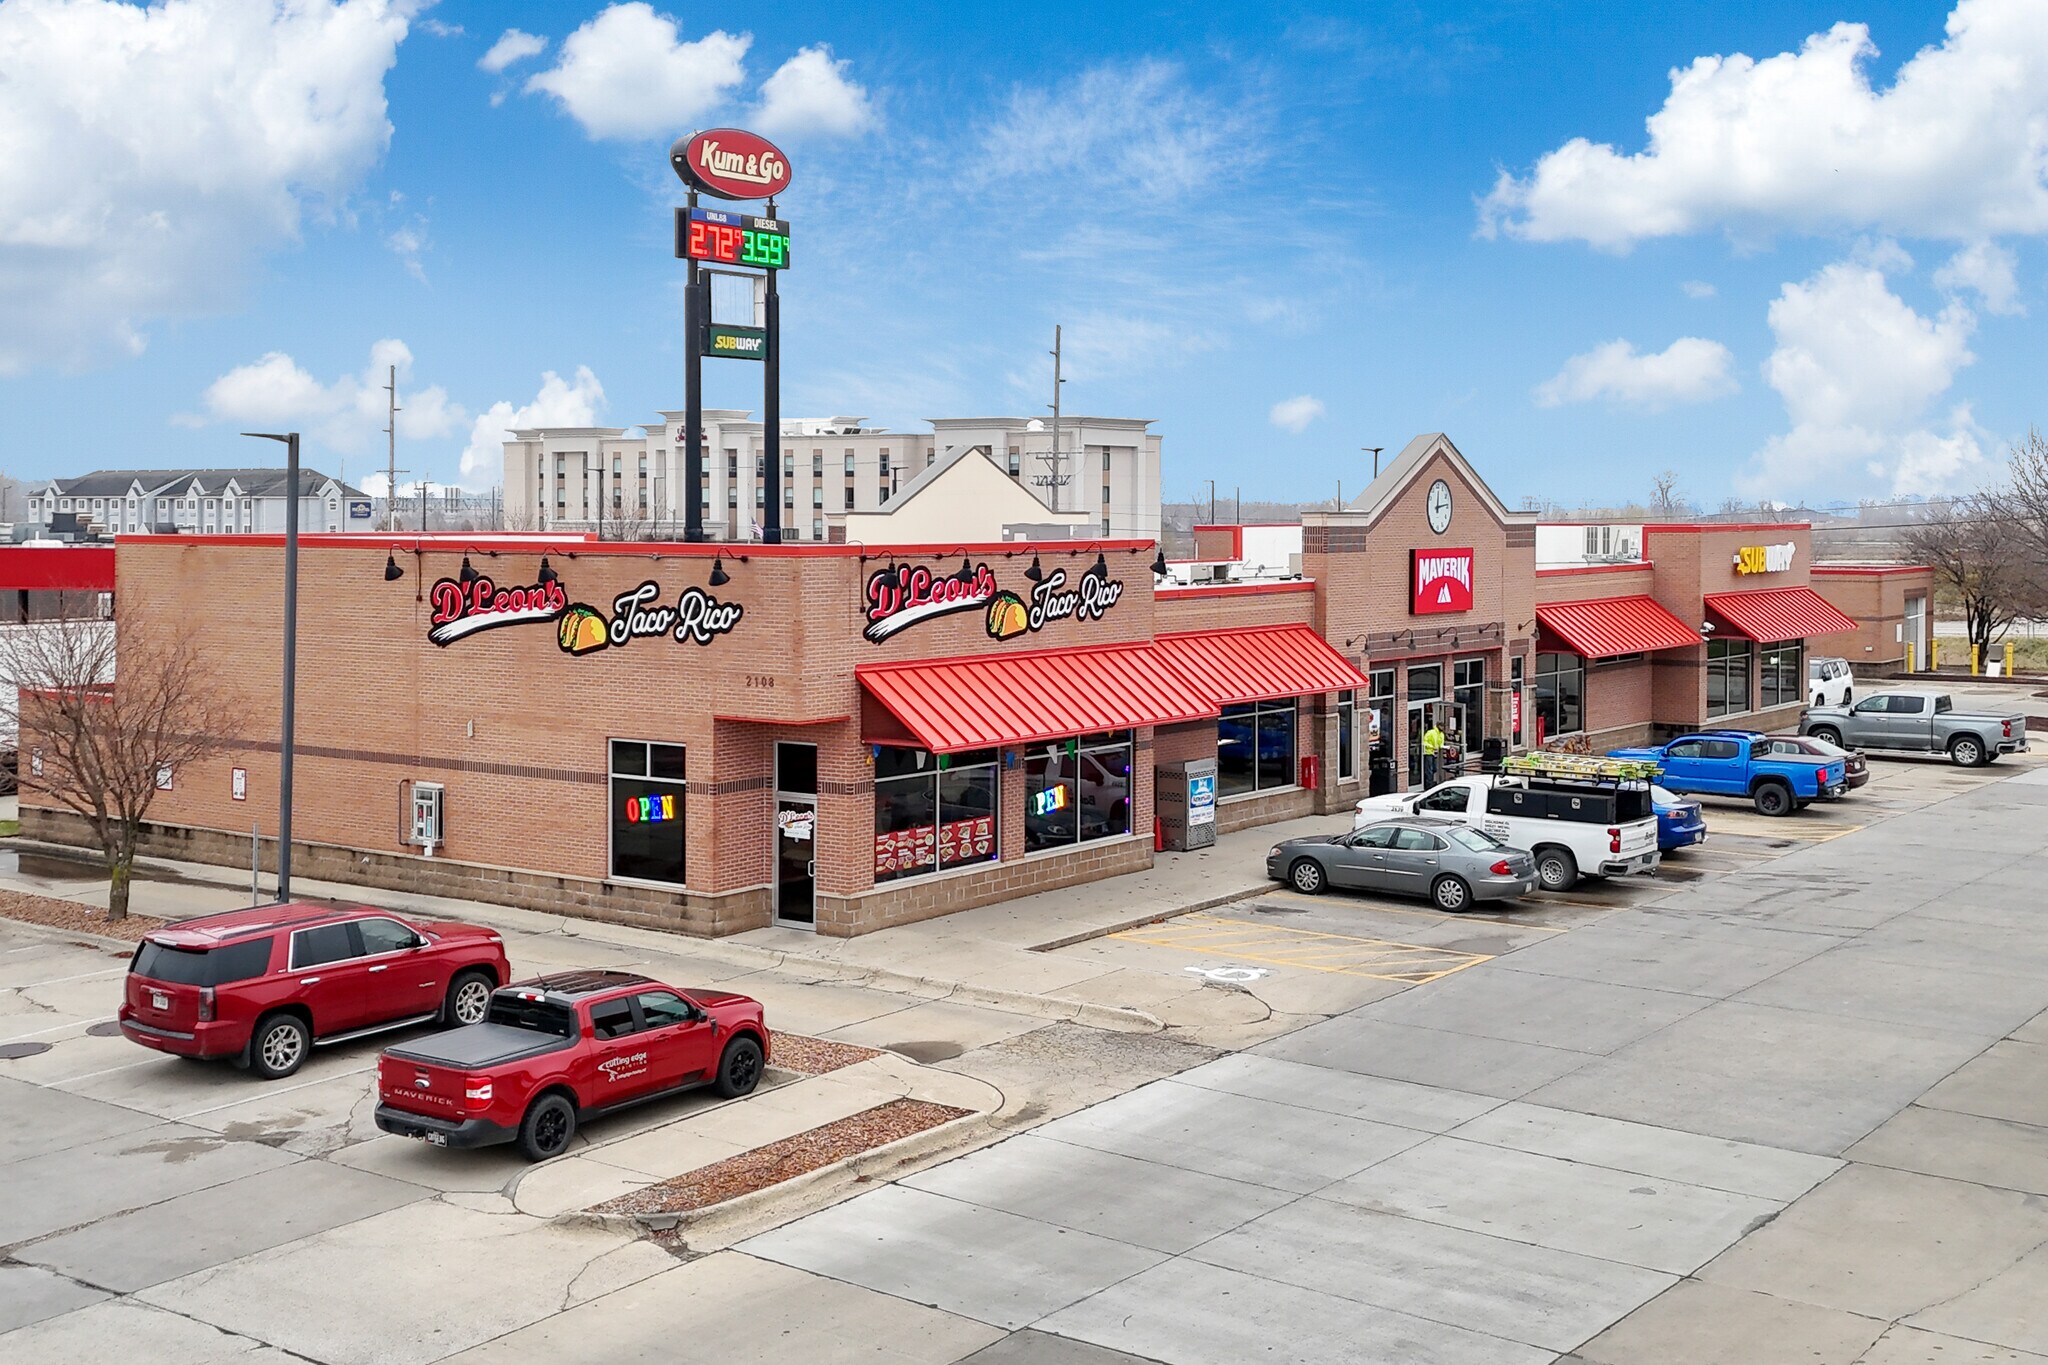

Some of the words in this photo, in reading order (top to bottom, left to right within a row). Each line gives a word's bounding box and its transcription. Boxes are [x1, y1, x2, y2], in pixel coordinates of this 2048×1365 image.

[700, 139, 744, 174] Kum
[745, 154, 758, 175] &
[759, 151, 784, 184] Go
[753, 217, 779, 231] DIESEL
[714, 335, 762, 351] SUBWAY
[1737, 541, 1796, 575] SUBWAY
[869, 566, 996, 619] D'Leon's
[1418, 556, 1470, 596] MAVERIK
[432, 579, 565, 623] D'Leon's
[610, 584, 675, 643] Taco
[676, 591, 740, 641] Rico
[1030, 572, 1079, 629] Taco
[1079, 573, 1122, 617] Rico
[745, 675, 775, 688] 2108
[626, 794, 674, 823] OPEN
[1029, 784, 1065, 816] OPEN
[394, 1089, 453, 1106] MAVERICK
